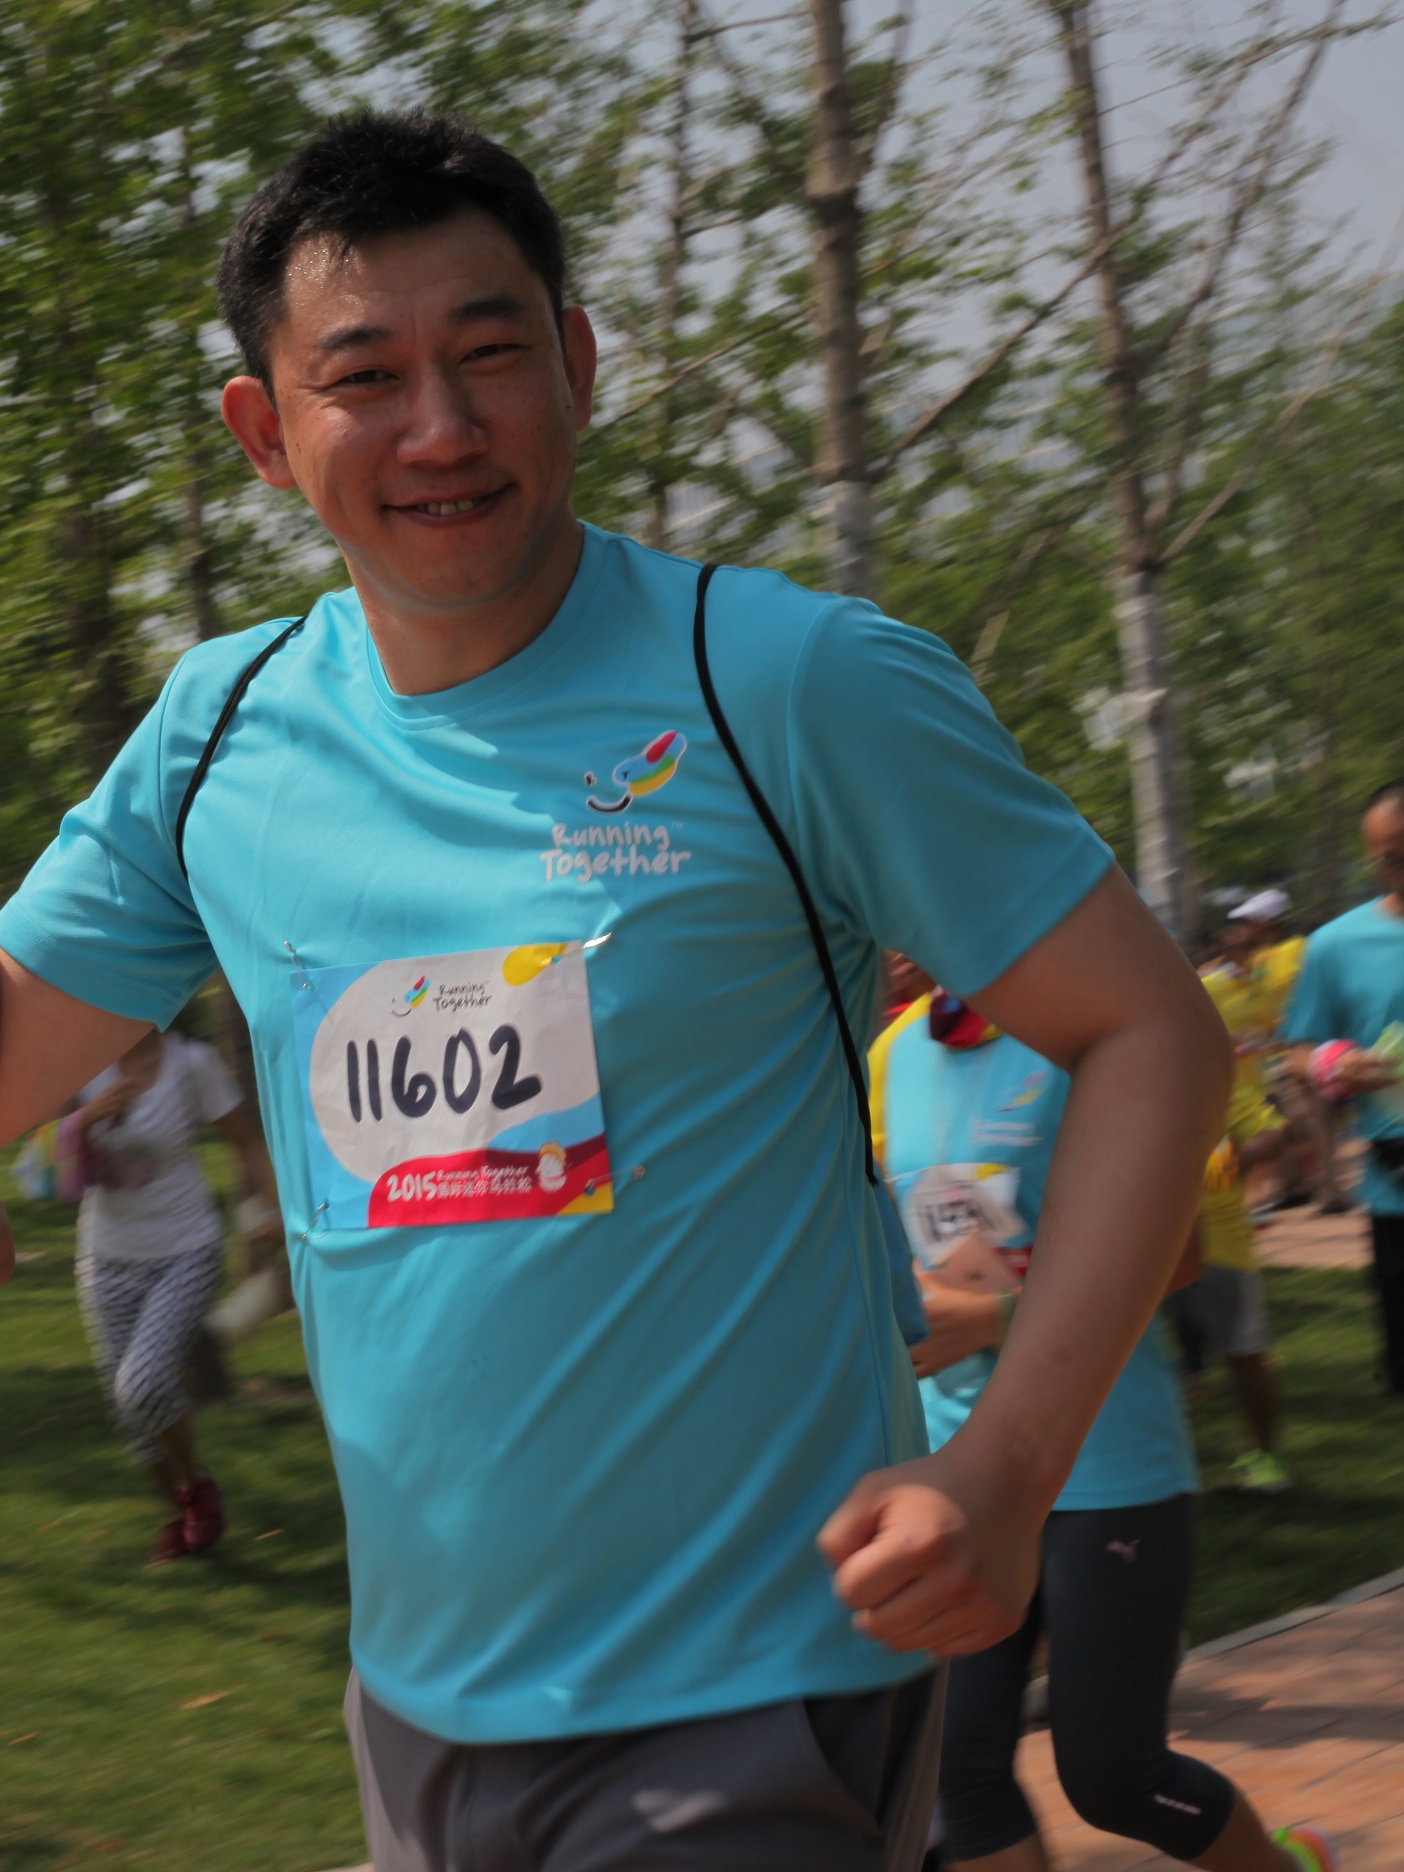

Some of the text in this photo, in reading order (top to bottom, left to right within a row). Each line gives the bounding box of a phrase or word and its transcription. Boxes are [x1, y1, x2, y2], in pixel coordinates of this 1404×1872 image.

[551, 821, 670, 850] Running
[539, 844, 692, 883] Together
[432, 994, 492, 1012] Together
[439, 982, 486, 996] Running
[347, 1023, 543, 1124] 11602
[386, 1170, 437, 1203] 2015
